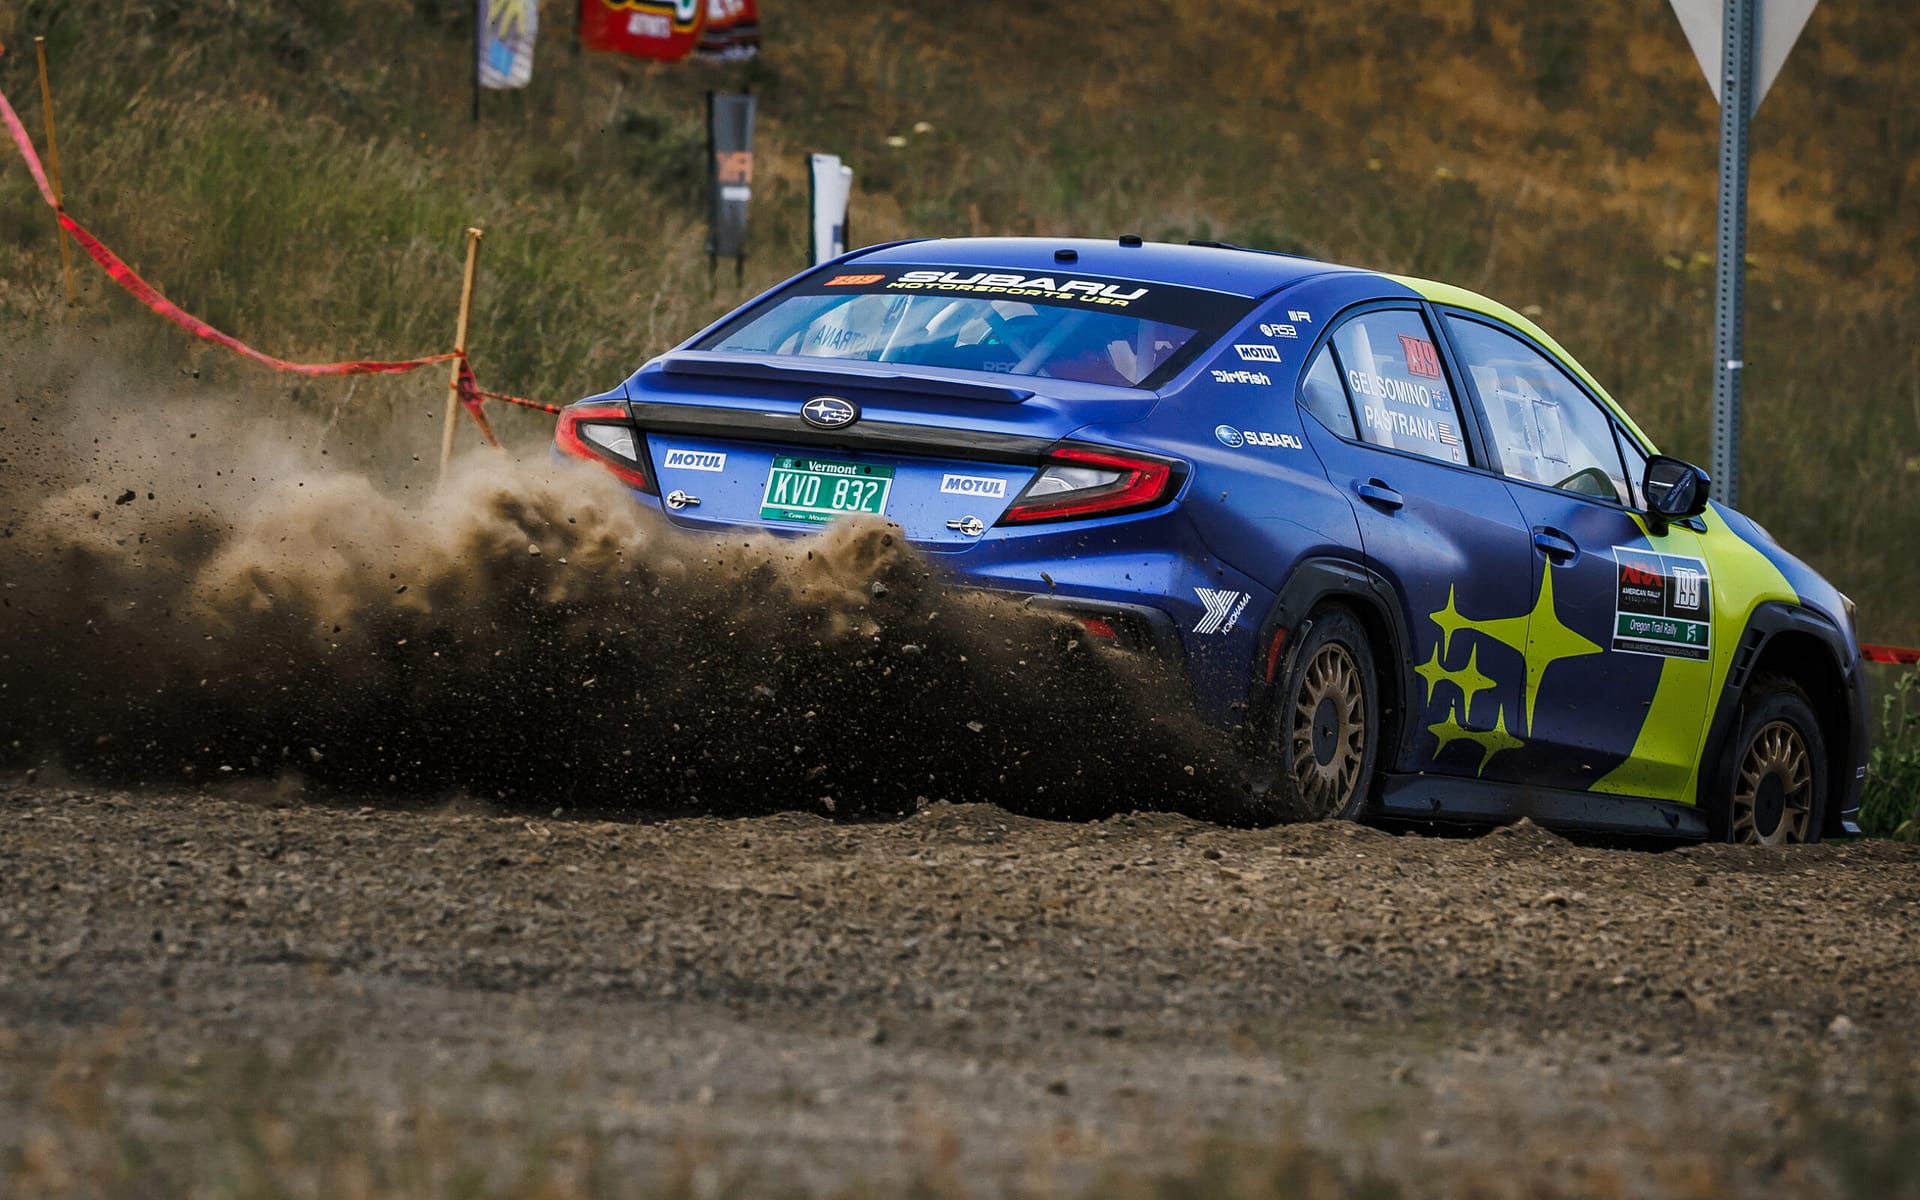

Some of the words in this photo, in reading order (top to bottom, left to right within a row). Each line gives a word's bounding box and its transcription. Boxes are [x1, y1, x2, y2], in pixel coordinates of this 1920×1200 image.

[886, 282, 1075, 300] MOTORSPORTS
[1080, 295, 1129, 308] USA
[898, 271, 1149, 300] SUBARU
[1240, 347, 1278, 359] MOTUL
[1398, 333, 1440, 380] 199
[1211, 370, 1271, 385] DirtFish
[1349, 369, 1430, 409] GELSOMINO
[1364, 404, 1438, 442] PASTRANA
[1243, 431, 1303, 449] SUBARU
[669, 453, 721, 468] MOTUL
[808, 460, 857, 475] Vermont
[774, 473, 821, 506] KVD
[832, 479, 878, 512] 832
[945, 478, 1001, 494] MOTUL
[1622, 587, 1647, 598] AMERICAN
[1647, 590, 1661, 599] RALLY
[1672, 566, 1699, 610] 199
[1221, 592, 1252, 636] YOKOHAMA
[1629, 618, 1651, 634] Oregon
[1651, 621, 1664, 634] Trail
[1663, 622, 1678, 638] Rally
